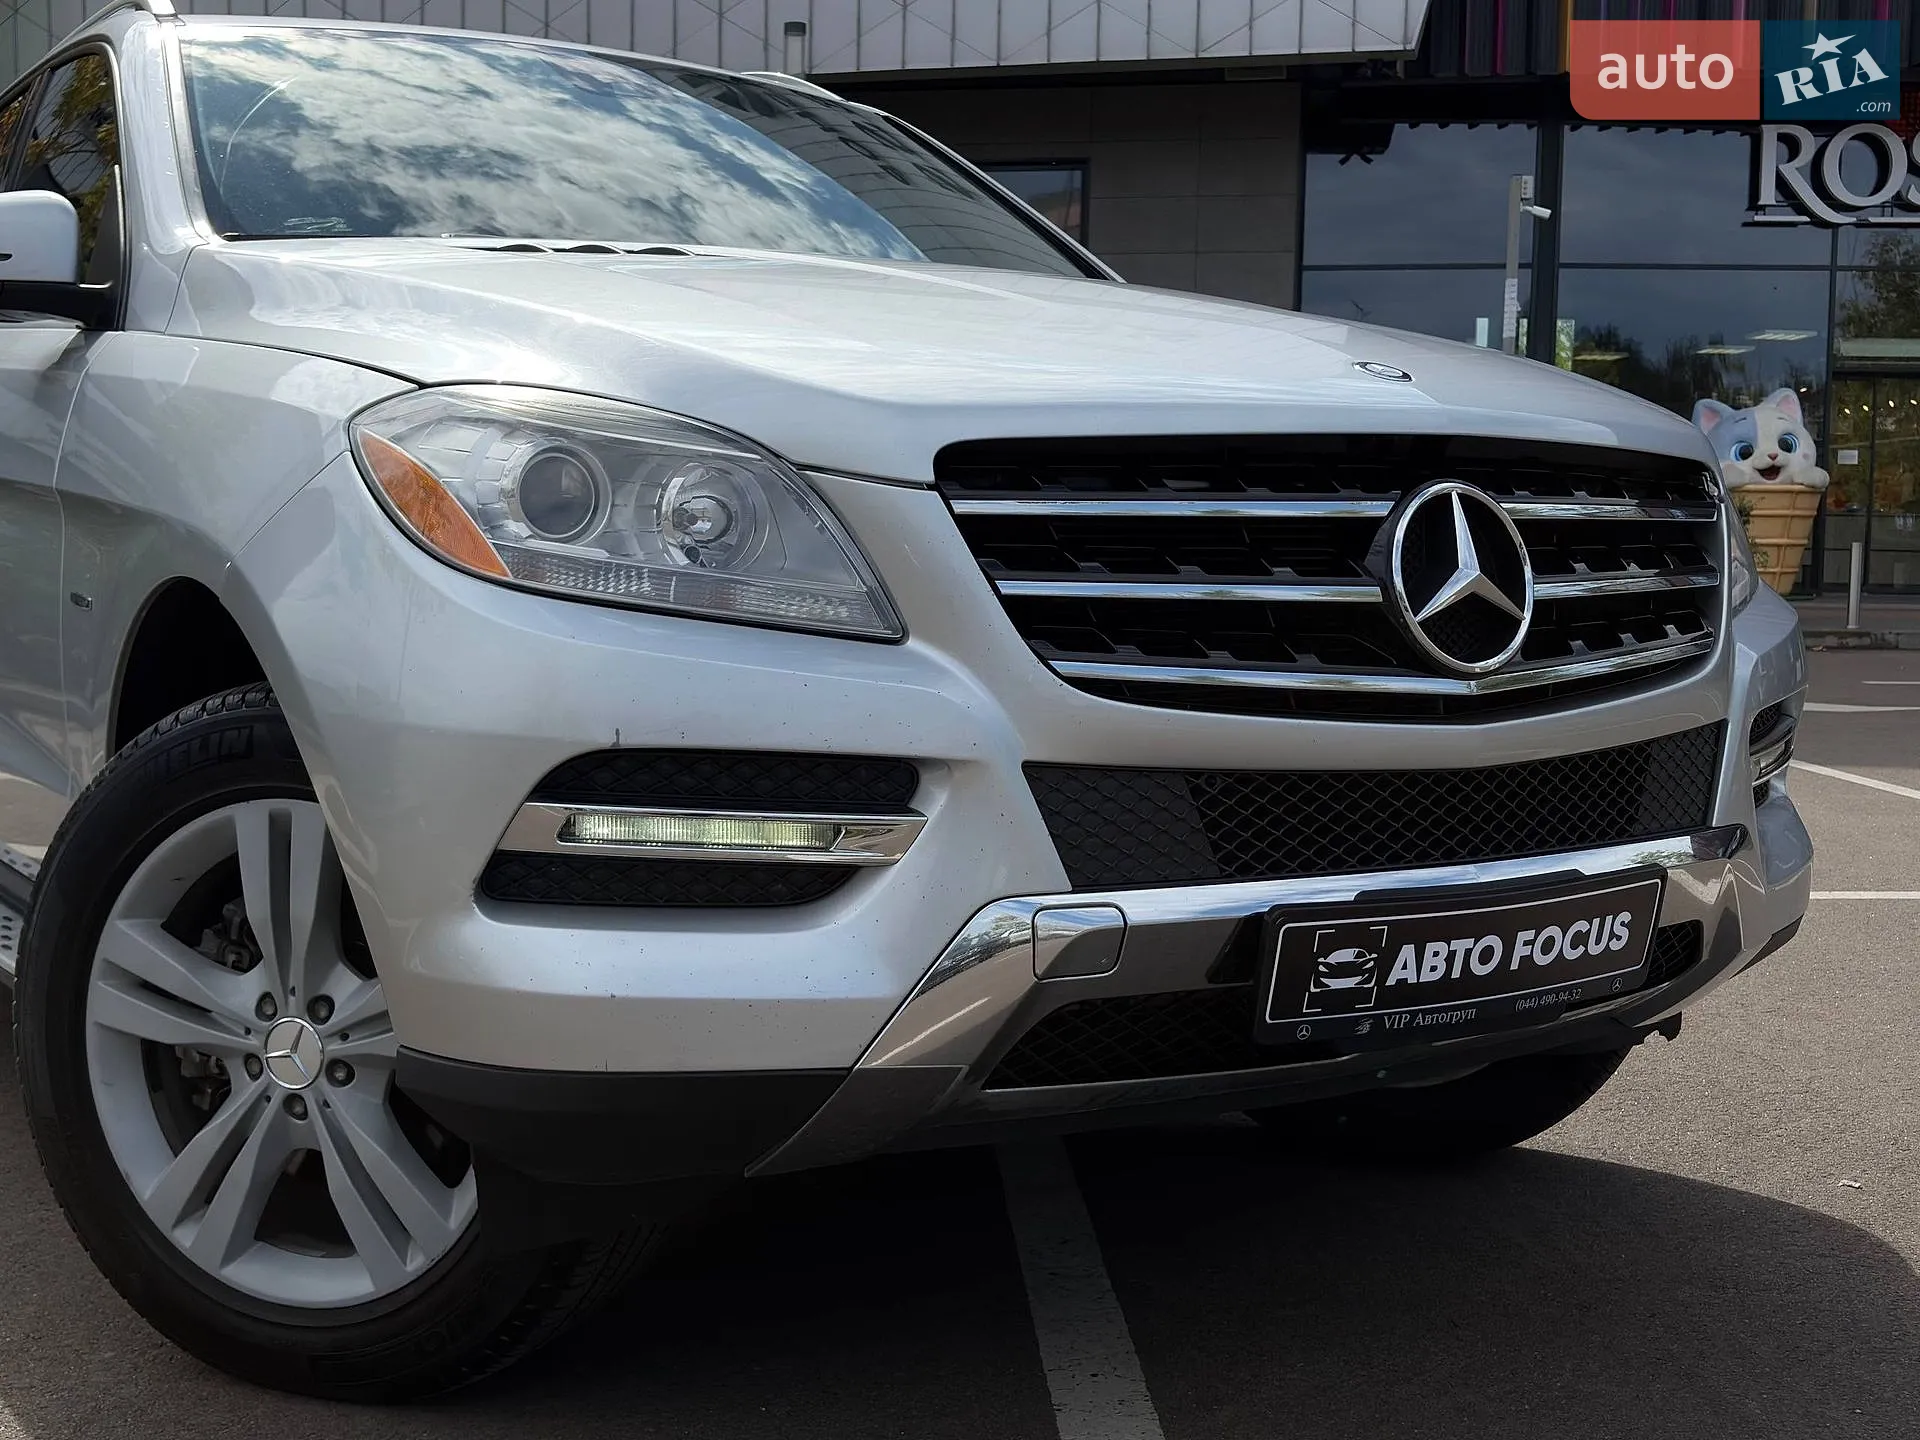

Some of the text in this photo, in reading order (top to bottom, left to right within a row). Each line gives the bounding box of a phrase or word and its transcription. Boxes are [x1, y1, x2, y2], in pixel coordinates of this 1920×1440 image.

[1385, 911, 1632, 987] АВТО FOCUS
[1515, 995, 1539, 1012] (044)
[1383, 1008, 1477, 1029] VIP Автогруп
